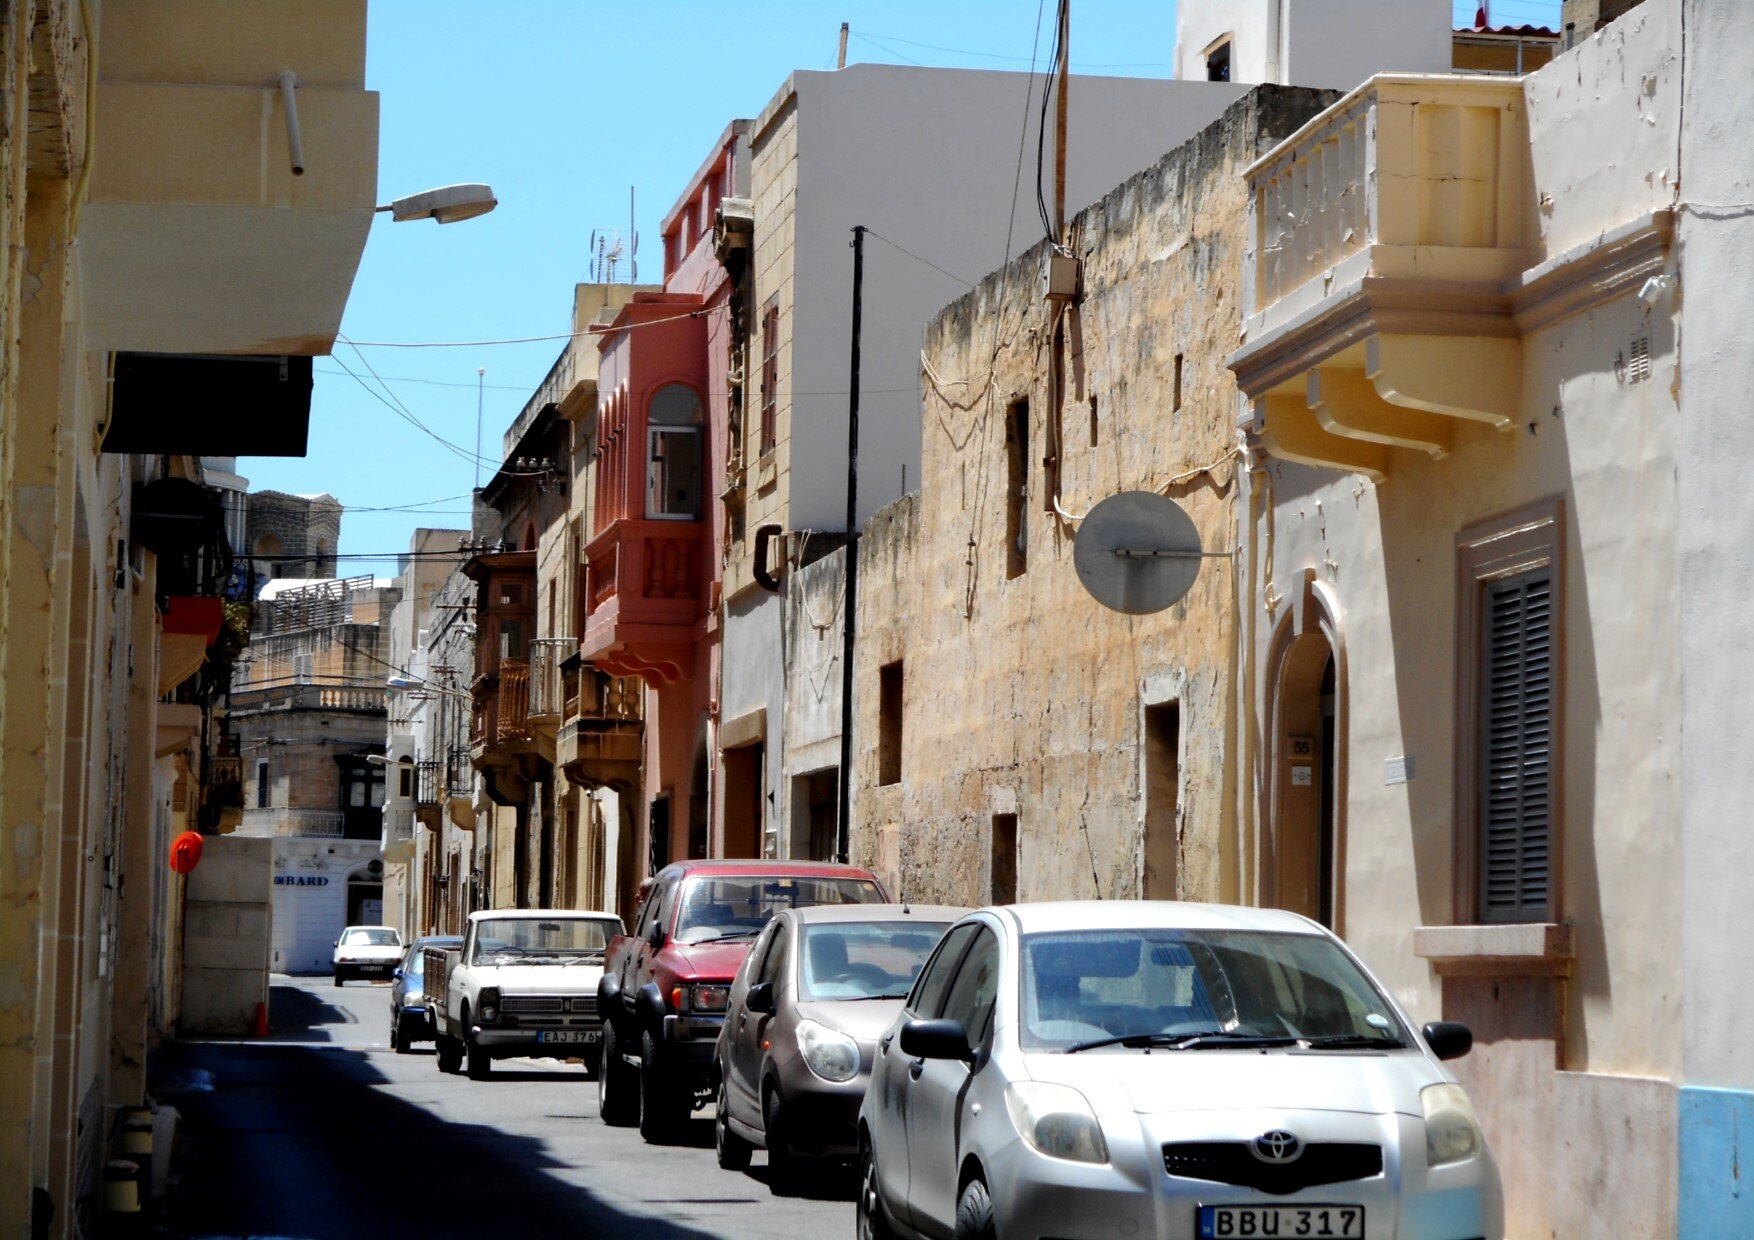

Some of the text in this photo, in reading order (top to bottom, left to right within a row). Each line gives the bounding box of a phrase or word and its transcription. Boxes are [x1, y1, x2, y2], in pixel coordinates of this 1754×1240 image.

[1294, 741, 1310, 754] 55
[544, 1032, 595, 1042] EAJ 376
[1217, 1211, 1356, 1235] BBU 317
